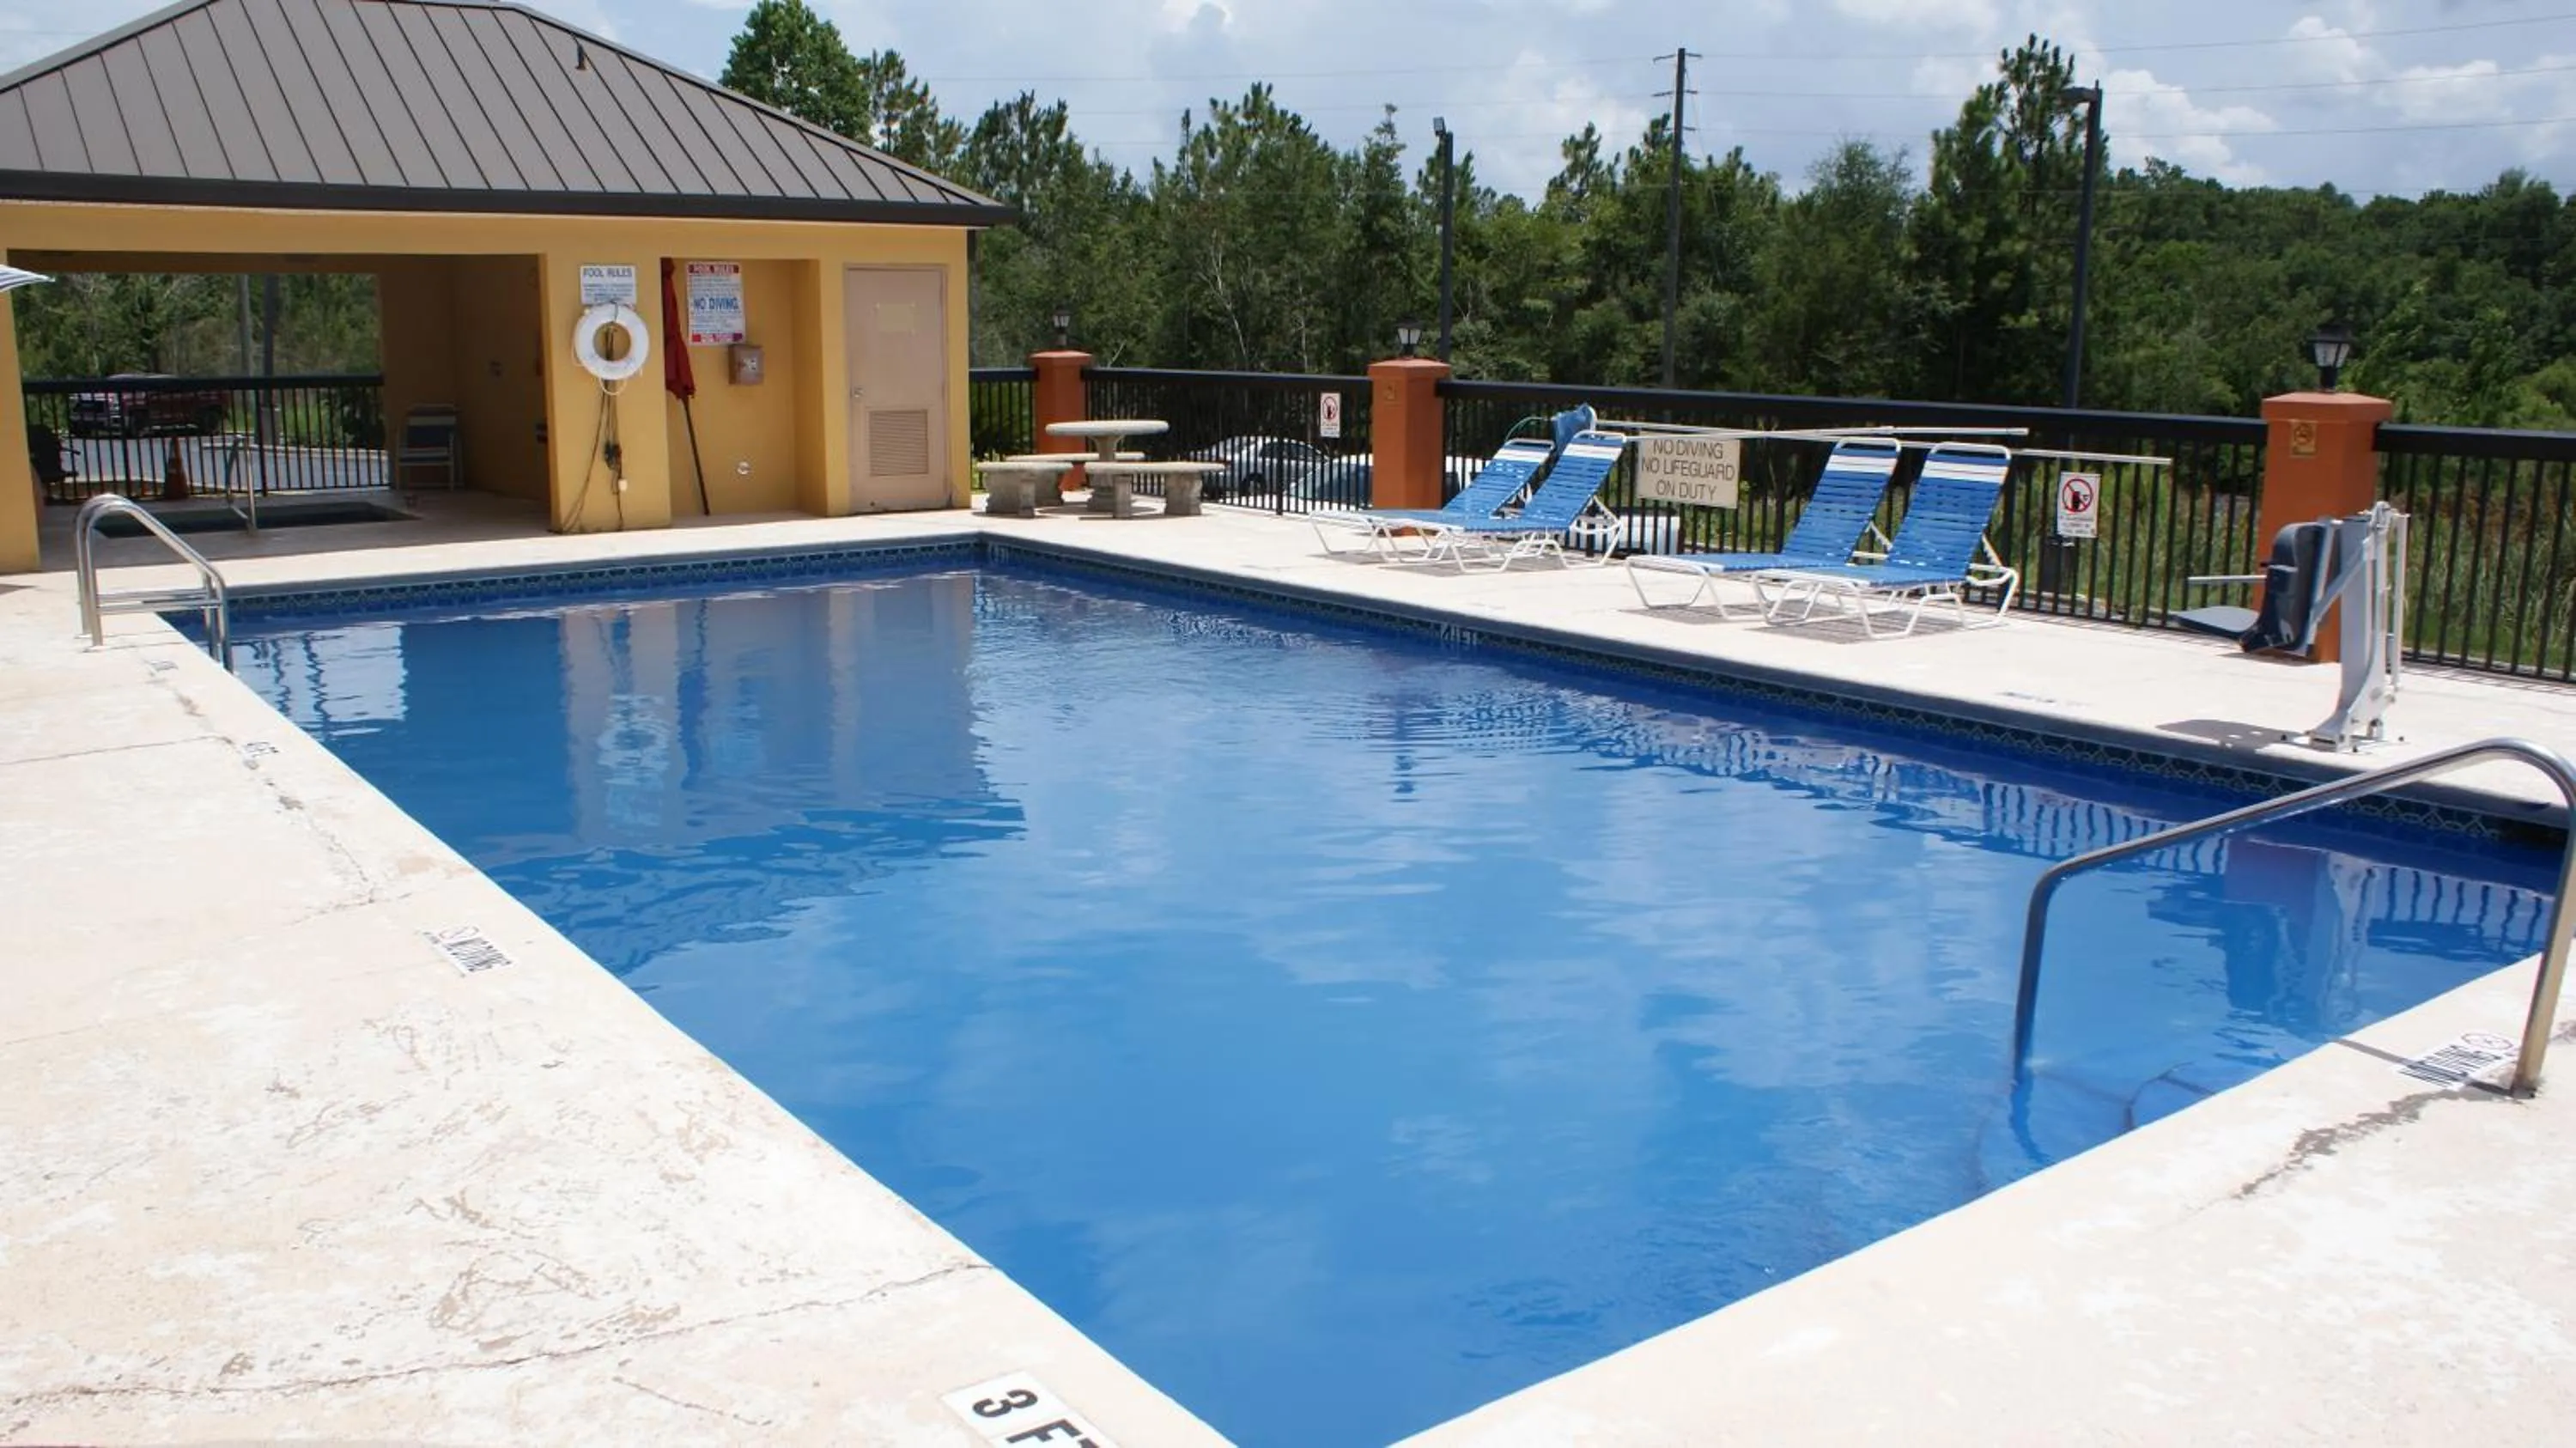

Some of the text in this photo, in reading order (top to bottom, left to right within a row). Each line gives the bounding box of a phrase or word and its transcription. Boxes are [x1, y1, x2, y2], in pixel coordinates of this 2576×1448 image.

[583, 267, 633, 277] POOL RULES
[694, 296, 738, 310] NO DIVING
[1654, 439, 1723, 459] NO DIVING
[1642, 457, 1735, 481] NO LIFEGUARD
[1656, 479, 1716, 500] ON DUTY
[972, 1389, 1099, 1448] 3 F
